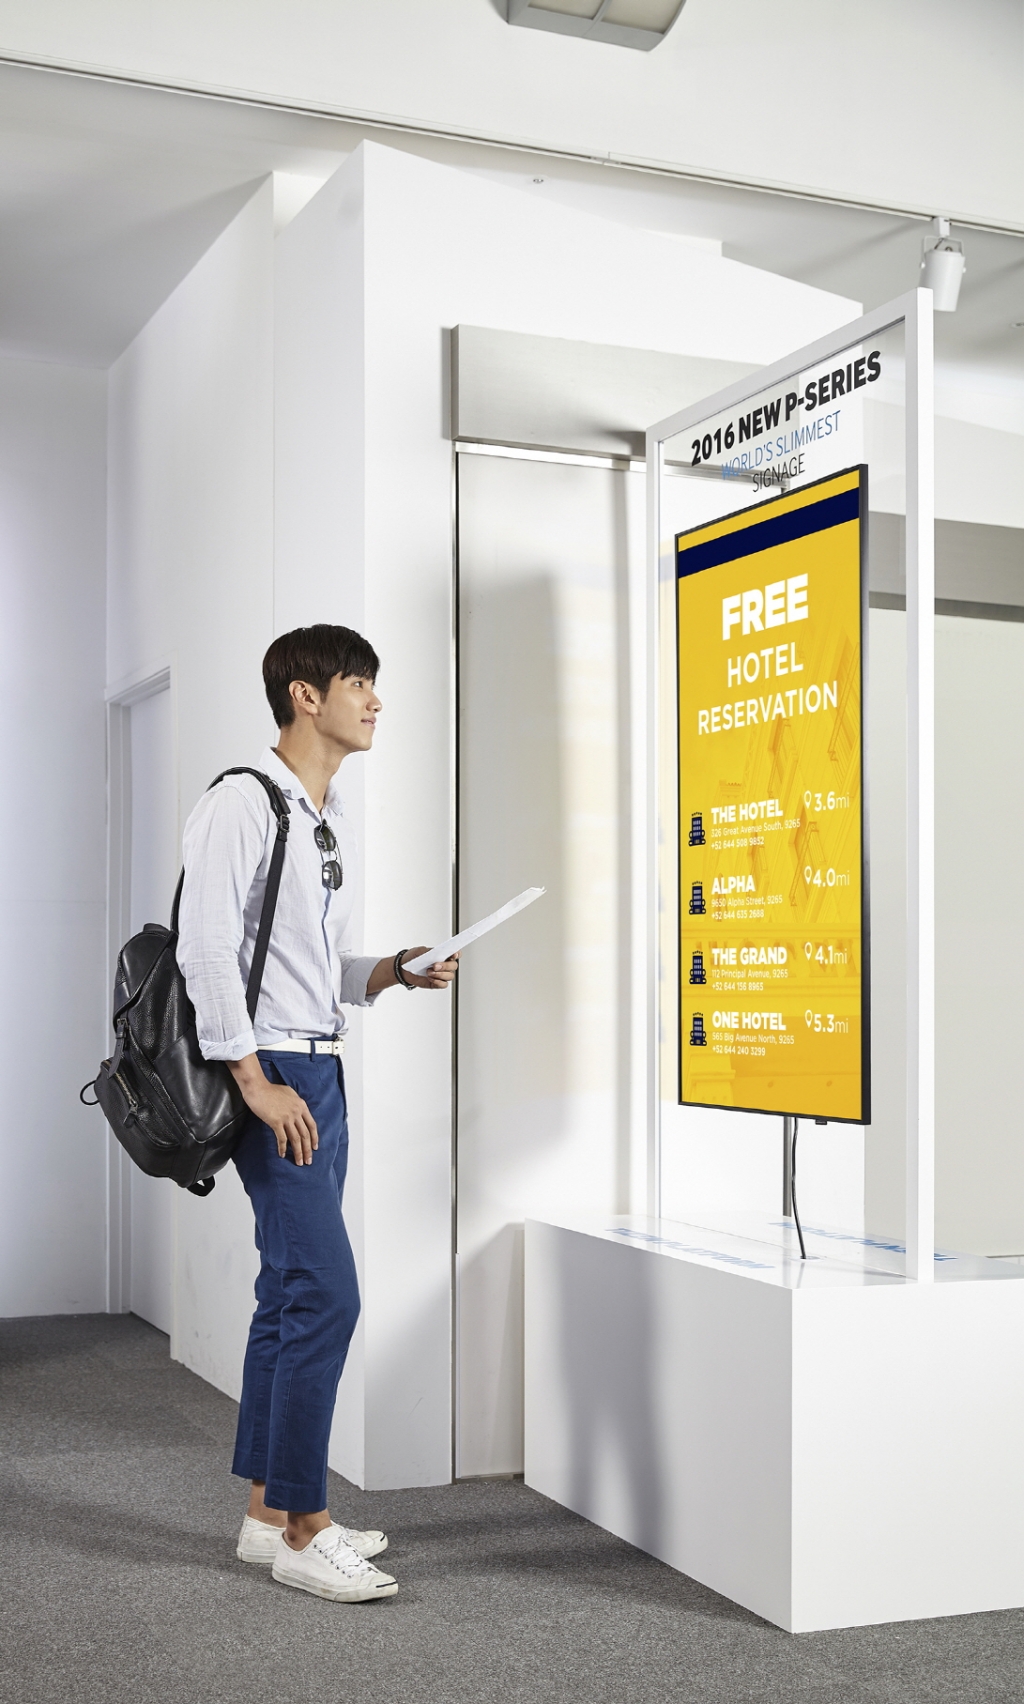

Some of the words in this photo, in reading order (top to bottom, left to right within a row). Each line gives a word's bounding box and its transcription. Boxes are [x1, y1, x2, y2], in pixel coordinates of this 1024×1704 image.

[691, 422, 735, 467] 2016
[739, 398, 782, 444] NEW
[785, 350, 881, 422] P-SERIES
[721, 441, 773, 480] WORLD'S
[776, 410, 841, 457] SLIMMEST
[752, 453, 806, 493] SIGNAGE
[722, 573, 808, 641] FREE
[727, 642, 804, 688] HOTEL
[698, 680, 838, 735] RESERVATION
[710, 805, 736, 825] THE
[739, 799, 783, 821] HOTEL
[723, 825, 739, 837] Great
[741, 823, 762, 834] Avenue
[763, 820, 783, 832] South,
[785, 819, 800, 829] 9265
[711, 840, 722, 850] +52
[723, 839, 735, 848] 644
[711, 875, 756, 895] ALPHA
[727, 896, 744, 908] Alpha
[745, 895, 766, 906] Street,
[767, 894, 783, 904] 9265
[712, 911, 722, 920] +52
[723, 910, 735, 919] 644
[736, 909, 748, 919] 635
[712, 948, 737, 965] THE
[740, 947, 787, 965] GRAND
[712, 969, 720, 978] 112
[721, 969, 746, 980] Principal
[747, 969, 771, 979] Avenue,
[772, 969, 788, 978] 9265
[712, 982, 722, 991] +52
[724, 982, 736, 991] 644
[712, 1011, 739, 1029] ONE
[741, 1011, 787, 1031] HOTEL
[724, 1033, 734, 1043] Big
[735, 1033, 757, 1043] Avenue
[758, 1034, 777, 1045] North,
[778, 1035, 795, 1045] 9265
[712, 1045, 723, 1054] +52
[724, 1046, 736, 1055] 644
[737, 1046, 749, 1056] 240
[750, 1047, 766, 1056] 3299
